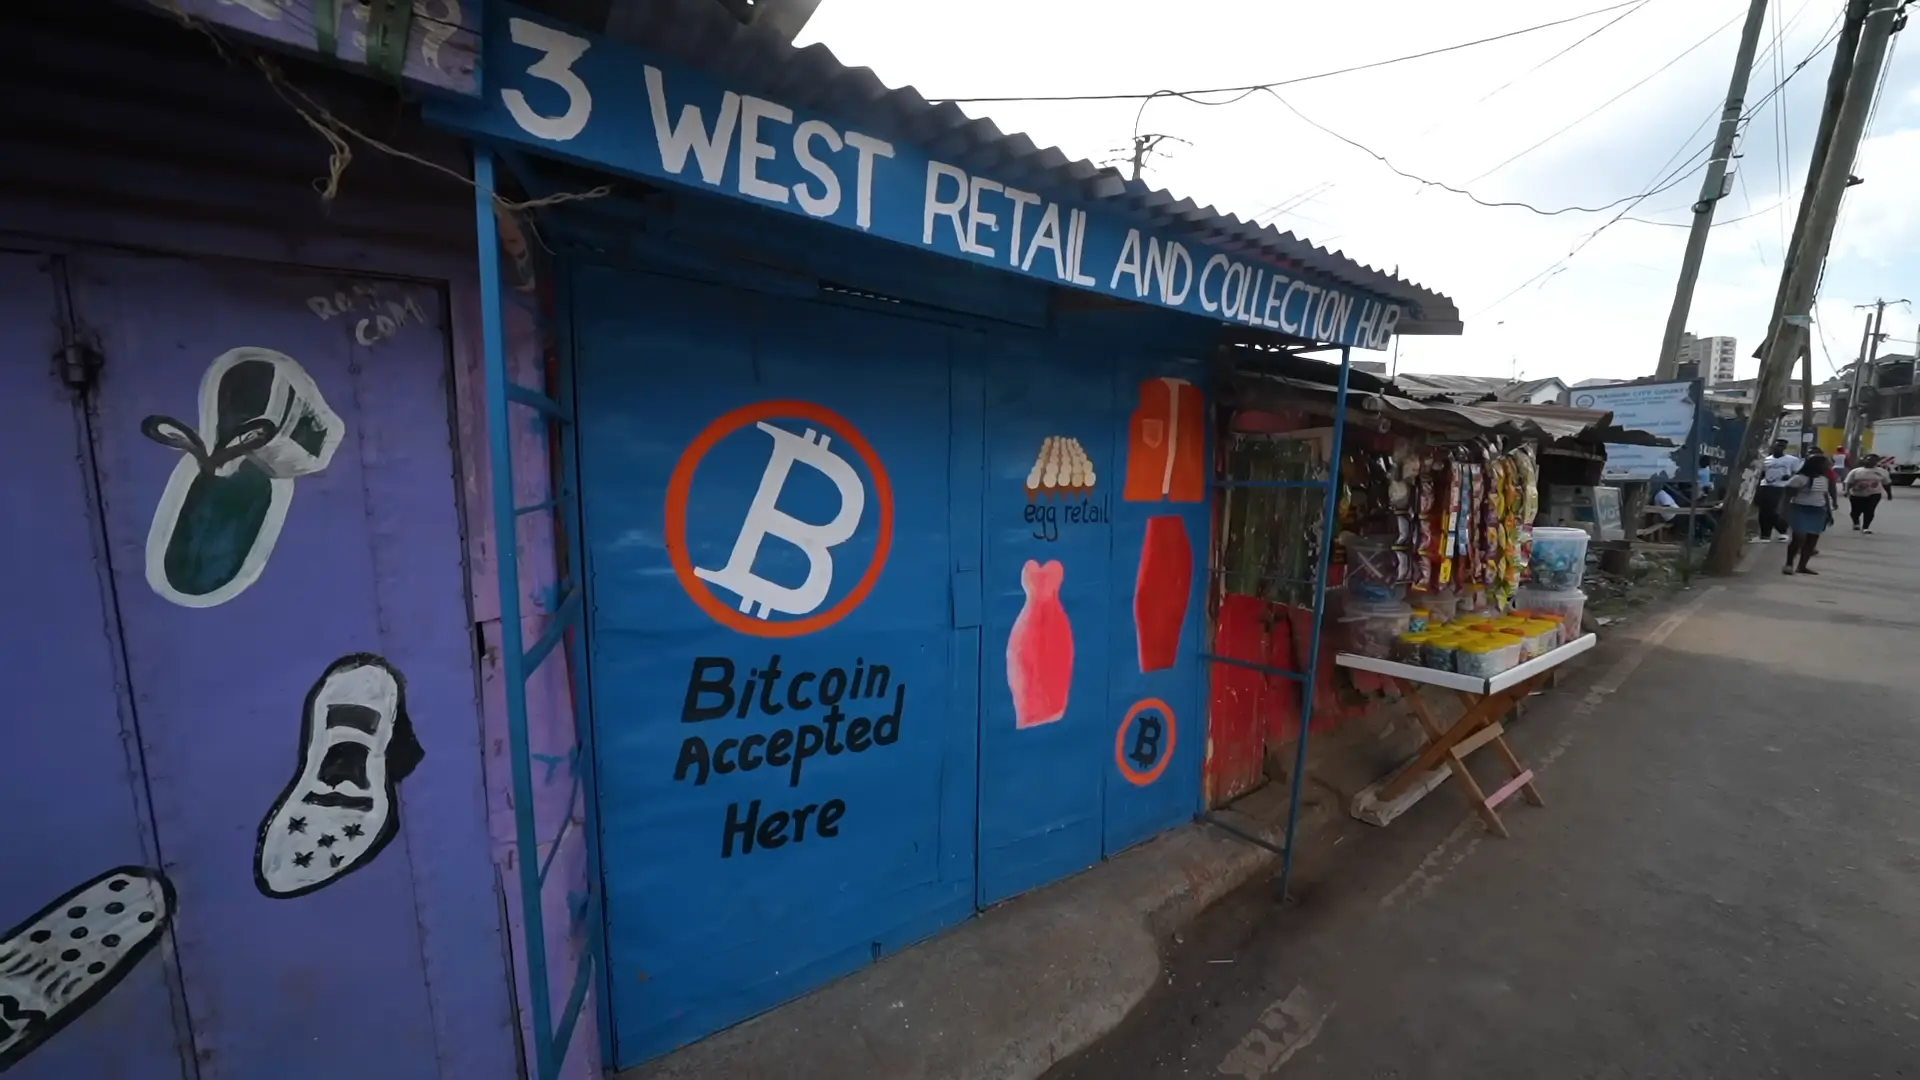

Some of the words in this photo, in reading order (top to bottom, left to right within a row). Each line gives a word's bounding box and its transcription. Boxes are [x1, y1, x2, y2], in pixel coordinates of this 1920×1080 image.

[501, 18, 592, 141] 3
[643, 64, 896, 231] WEST
[922, 160, 1096, 287] RETAIL
[1110, 229, 1193, 306] AND
[1199, 253, 1354, 342] COLLECTION
[1354, 299, 1400, 351] HUB
[1023, 503, 1058, 542] egg
[1064, 491, 1109, 524] retail
[681, 654, 891, 723] Bitcoin
[673, 683, 906, 788] Accepted
[721, 798, 846, 859] Here
